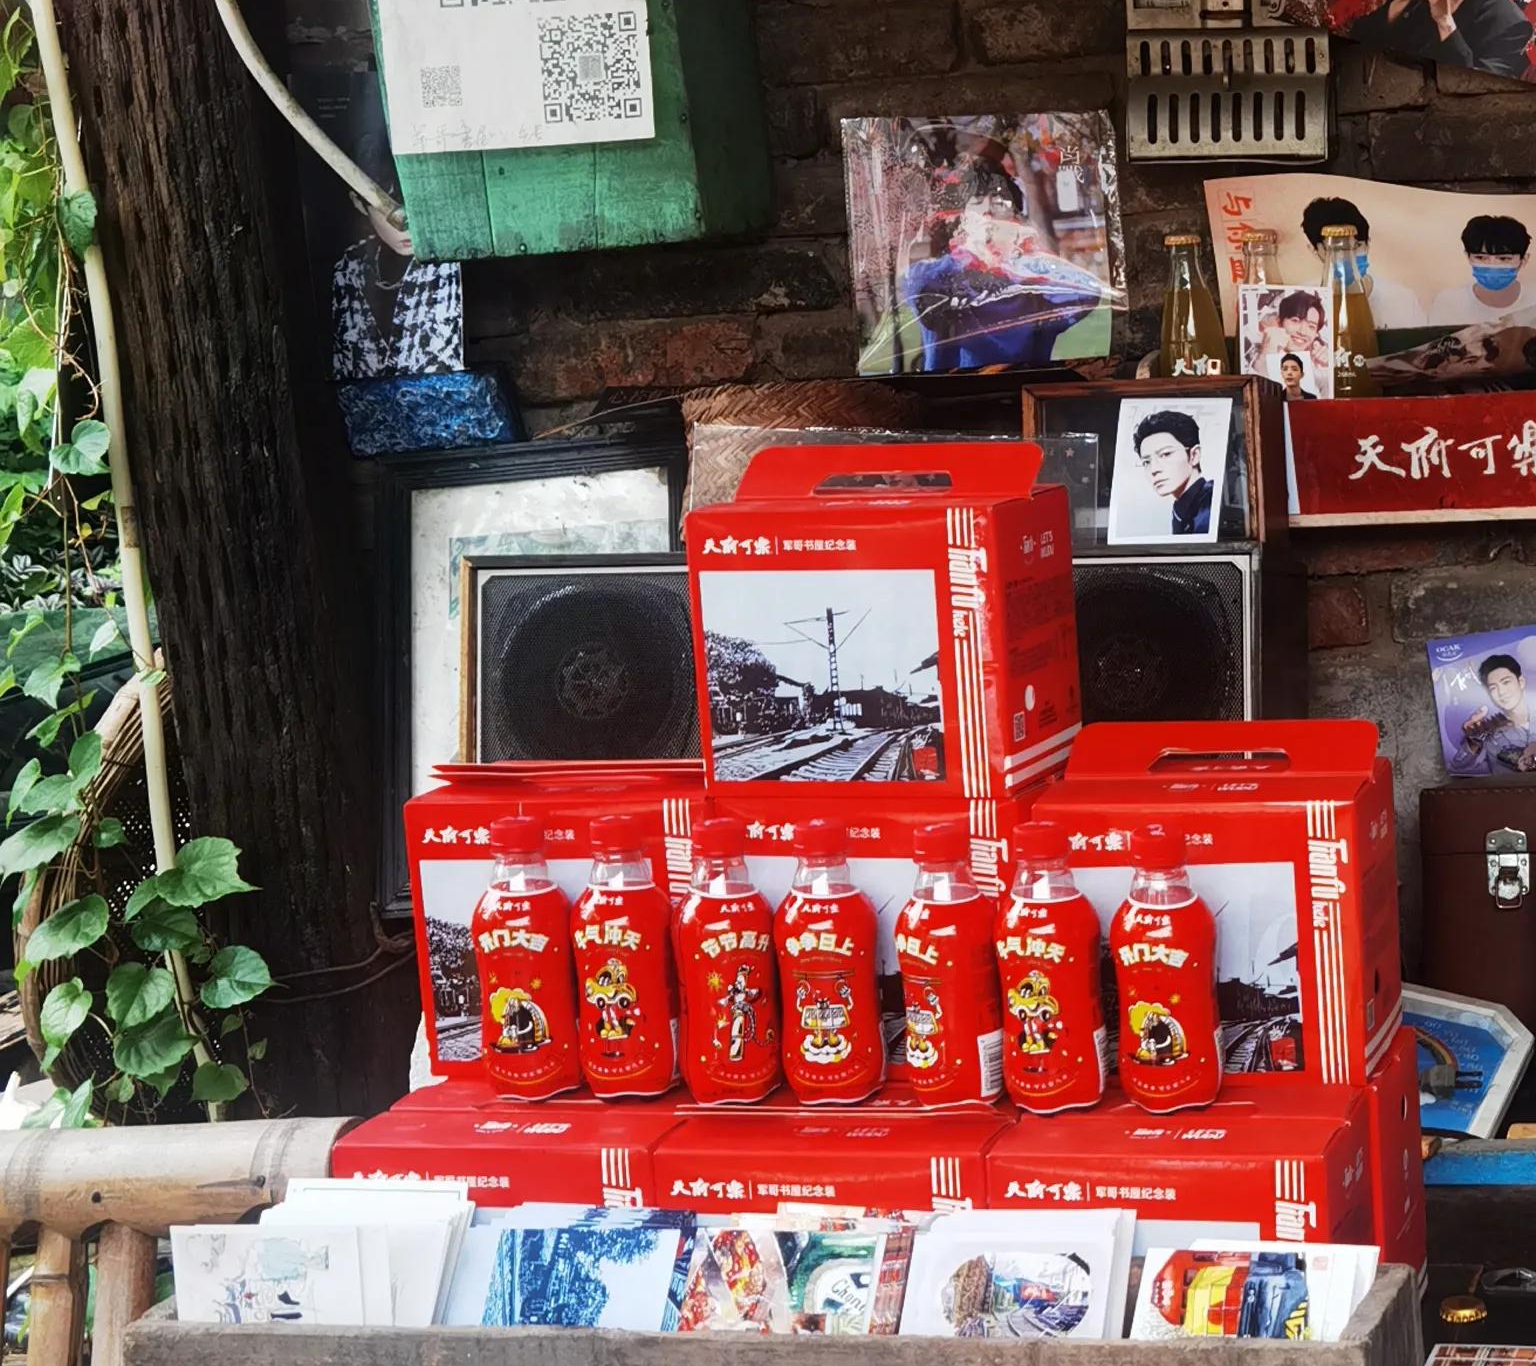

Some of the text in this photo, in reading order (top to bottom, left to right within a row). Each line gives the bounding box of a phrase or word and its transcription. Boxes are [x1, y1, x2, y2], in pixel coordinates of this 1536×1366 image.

[783, 537, 858, 553] 军哥书屋纪念装
[757, 1183, 837, 1199] 军哥书屋纪念装
[1095, 1185, 1178, 1202] 军哥书屋纪念装
